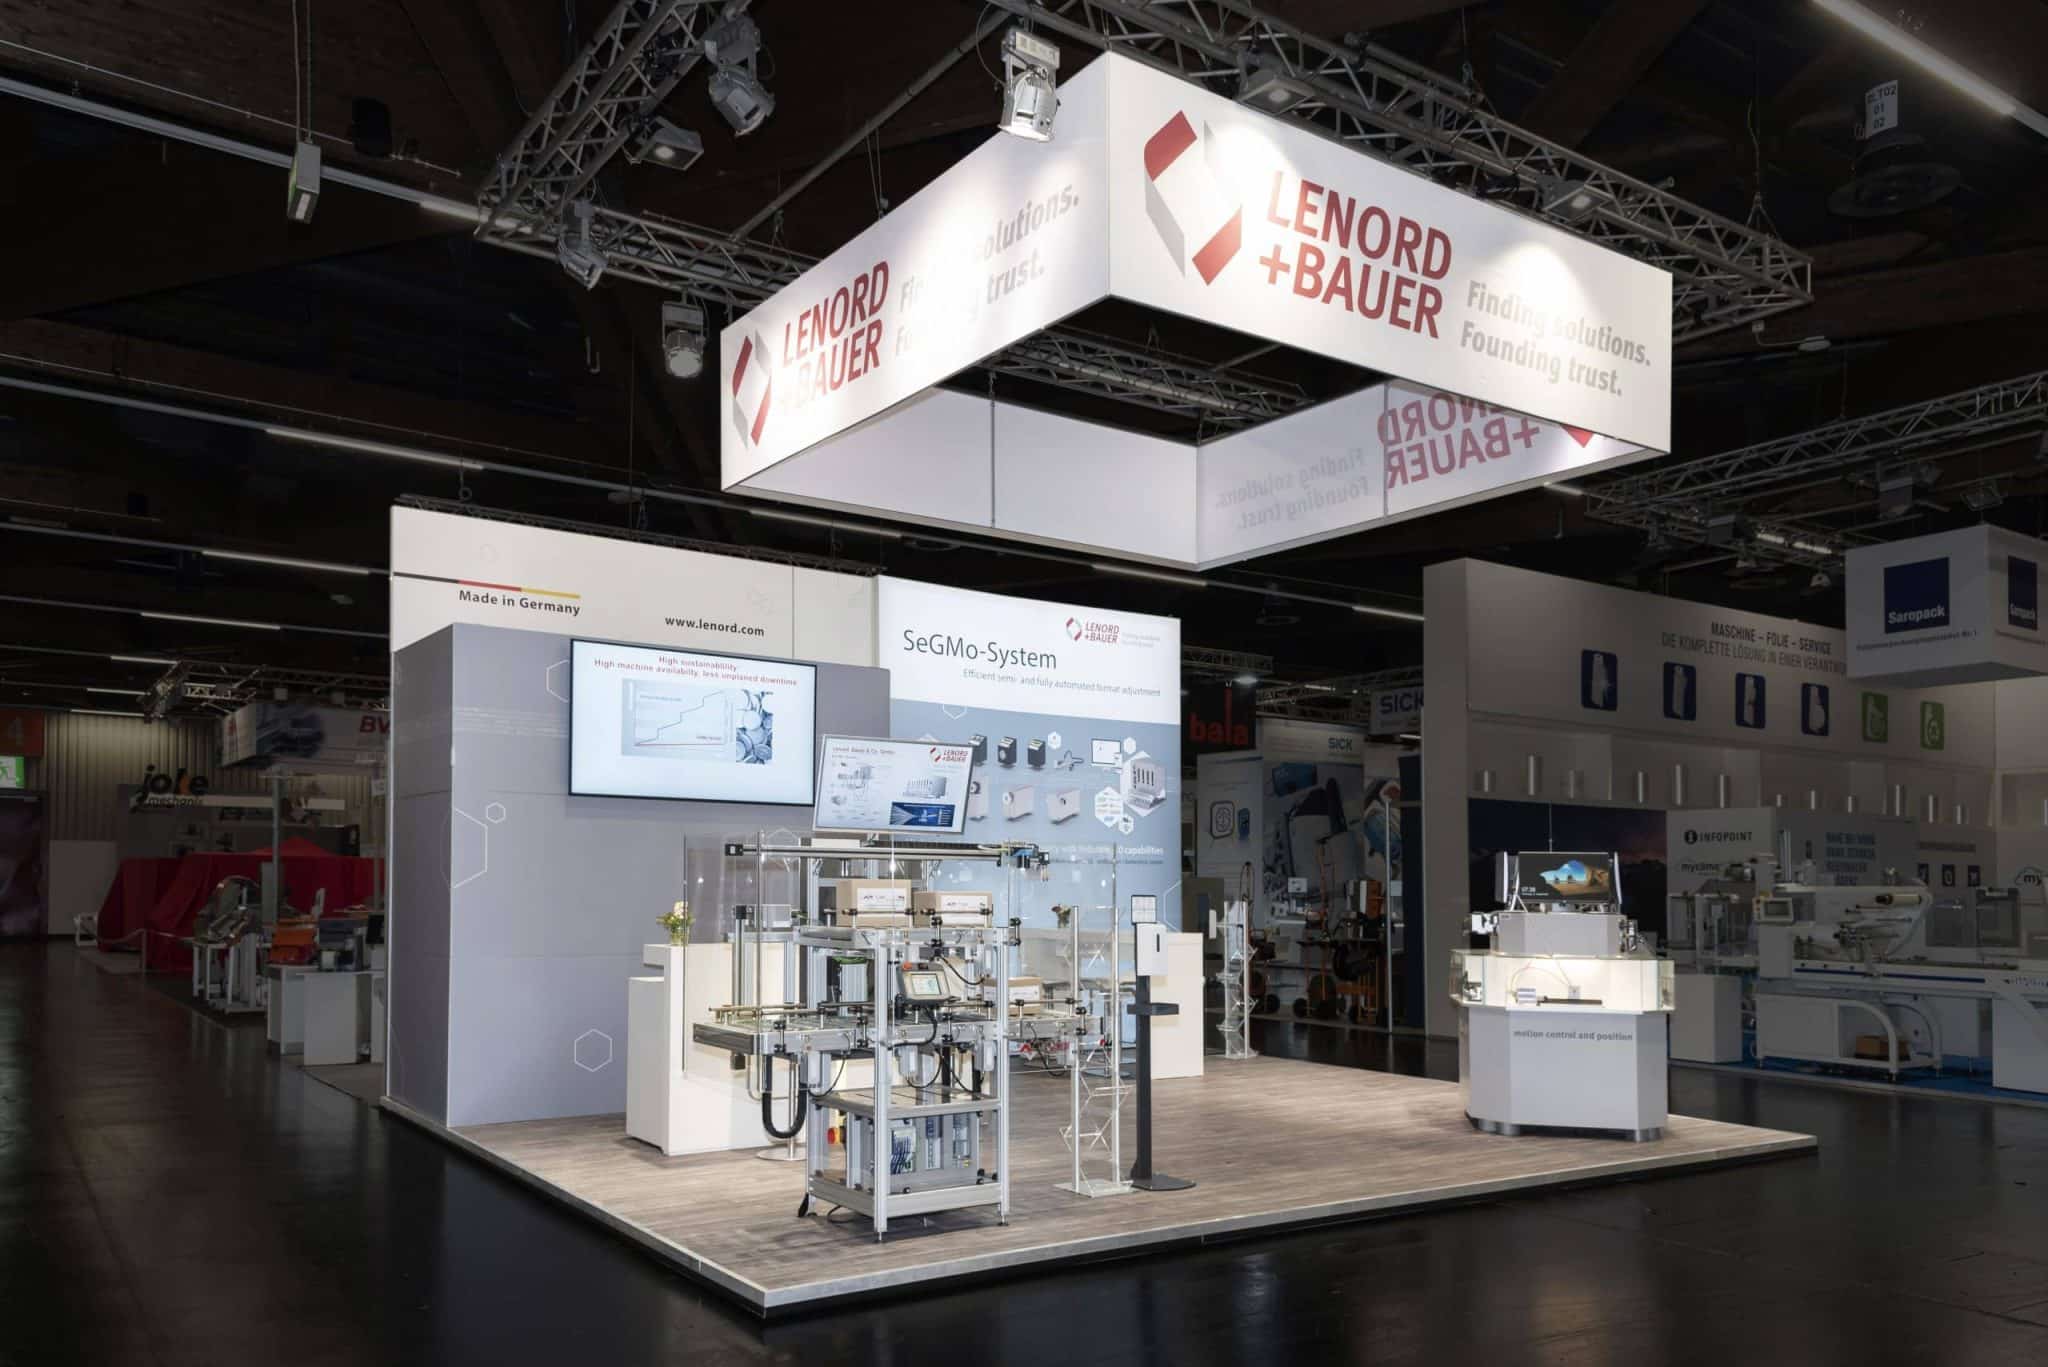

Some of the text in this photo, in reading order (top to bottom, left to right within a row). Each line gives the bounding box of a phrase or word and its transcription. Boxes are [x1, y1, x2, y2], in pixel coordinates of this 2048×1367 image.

[983, 185, 1079, 262] olutions.
[1267, 170, 1452, 280] LENORD
[986, 247, 1045, 305] trust.
[1259, 242, 1443, 339] +BAUER
[784, 261, 889, 358] LENORD
[1467, 279, 1651, 367] Finding solutions.
[799, 319, 882, 400] AUER
[1461, 320, 1622, 396] Founding trust.
[459, 589, 580, 617] Made in Germany
[1888, 604, 1945, 624] Saropack
[665, 616, 765, 637] www.lenord.com
[1085, 621, 1120, 634] LENORD
[1085, 631, 1119, 644] +BAUER
[1711, 621, 1756, 642] MASCHINE
[1766, 631, 1789, 648] FOLIE
[1799, 637, 1832, 656] SERVICE
[904, 629, 1057, 670] SeGMo-System
[1662, 631, 1677, 648] DIE
[1679, 634, 1730, 657] KOMPLETTE
[594, 658, 616, 670] High
[617, 661, 654, 672] machine
[658, 656, 680, 667] High
[963, 668, 996, 682] Efficient
[1020, 675, 1036, 686] and
[1036, 676, 1054, 689] fully
[1054, 679, 1096, 691] automated
[1379, 693, 1424, 714] SICK
[1328, 737, 1353, 751] SICK
[1699, 831, 1753, 843] INFOPOINT
[1513, 1029, 1633, 1042] motion control and position
